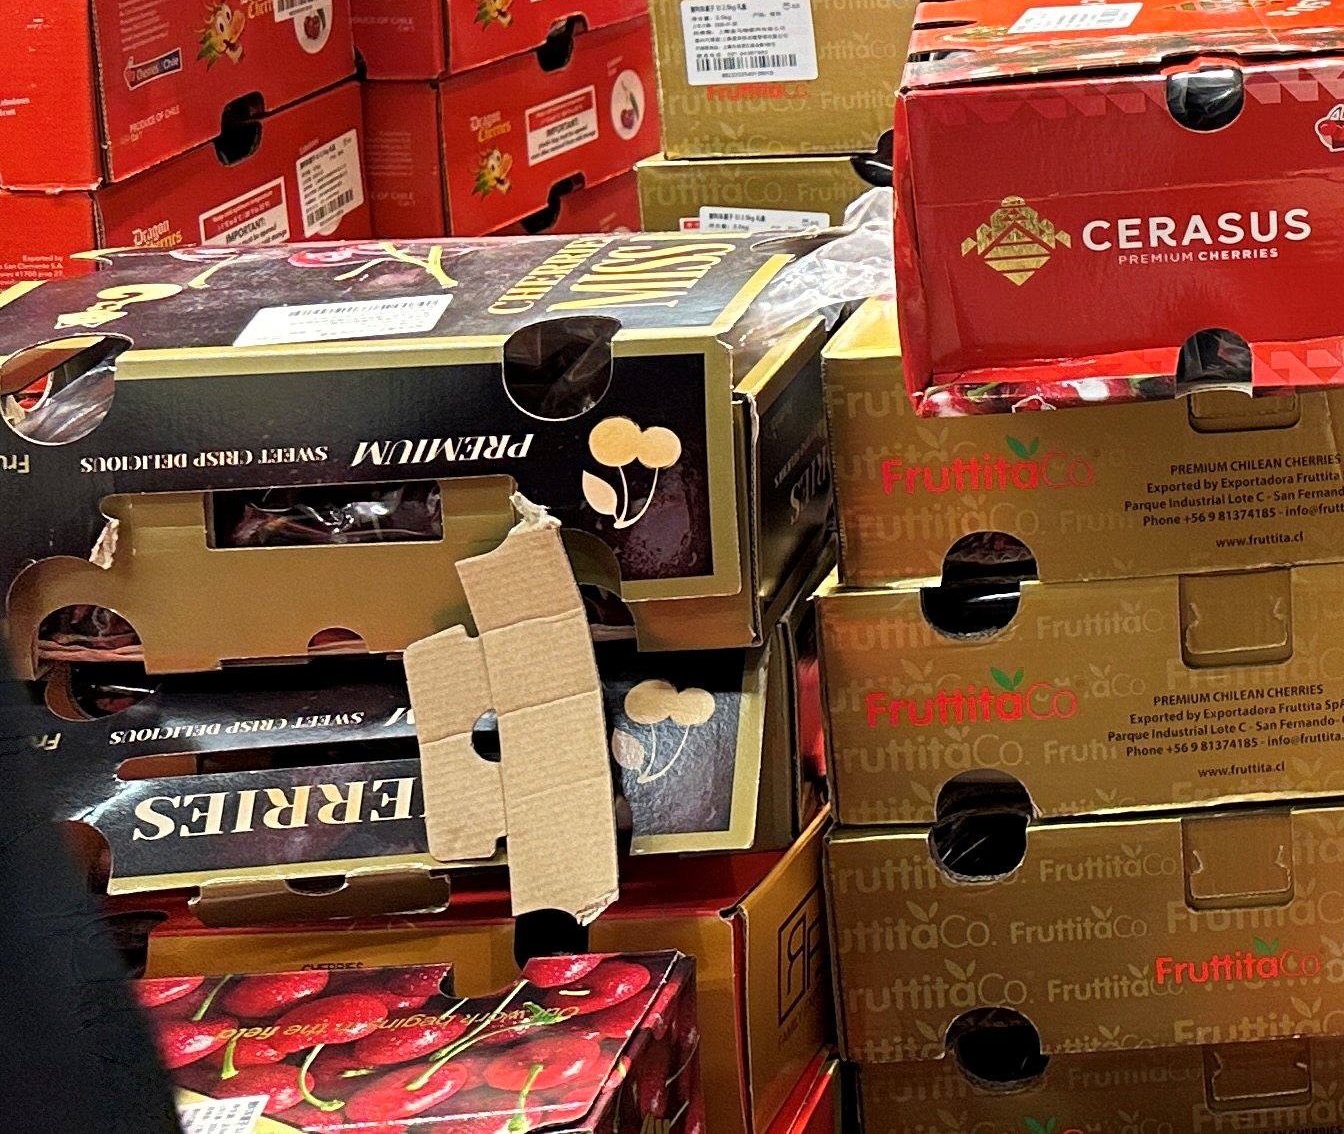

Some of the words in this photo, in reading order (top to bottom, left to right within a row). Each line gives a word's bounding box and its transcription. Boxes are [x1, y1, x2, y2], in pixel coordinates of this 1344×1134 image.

[1082, 208, 1312, 252] CERASUS
[1117, 250, 1194, 266] PREMIUM
[1198, 247, 1279, 263] CHERRIES
[193, 448, 254, 468] CRISP
[257, 446, 329, 465] SWEET
[351, 433, 535, 467] PREMIUM
[80, 451, 188, 474] DELICIOUS
[1170, 462, 1228, 476] PREMIUM
[1230, 458, 1282, 472] CHILEAN
[1284, 454, 1342, 468] CHERRIES
[1147, 480, 1200, 495] Exported
[1203, 478, 1218, 492] by
[1221, 474, 1294, 490] Exportadora
[1296, 471, 1340, 483] Fruttita
[1124, 499, 1166, 514] Parque
[1169, 495, 1225, 508] Industrial
[1228, 494, 1254, 504] Lote
[1256, 492, 1264, 503] C
[1274, 490, 1296, 502] San
[1143, 514, 1181, 526] Phone
[1184, 512, 1206, 524] +56
[1207, 510, 1216, 522] 9
[1217, 507, 1276, 521] 81374185
[1216, 531, 1304, 548] www.fruttita.cl
[1153, 694, 1211, 706] PREMIUM
[1212, 688, 1265, 702] CHILEAN
[1267, 684, 1324, 698] CHERRIES
[293, 711, 365, 729] SWEET
[1130, 712, 1184, 726] Exported
[1186, 710, 1201, 722] by
[1203, 704, 1277, 720] Exportadora
[1279, 701, 1322, 714] Fruttita
[109, 720, 220, 746] DELICIOUS
[226, 716, 290, 734] CRISP
[1108, 730, 1150, 744] Parque
[1152, 726, 1208, 739] Industrial
[1211, 724, 1236, 735] Lote
[1239, 722, 1247, 733] C
[1255, 720, 1278, 732] San
[1126, 744, 1164, 758] Phone
[1166, 743, 1189, 754] +56
[1190, 742, 1198, 752] 9
[1200, 737, 1258, 752] 81374185
[1198, 762, 1286, 778] www.fruttita.cl
[133, 777, 424, 841] ERRIES
[216, 1023, 281, 1046] field
[285, 1020, 326, 1042] the
